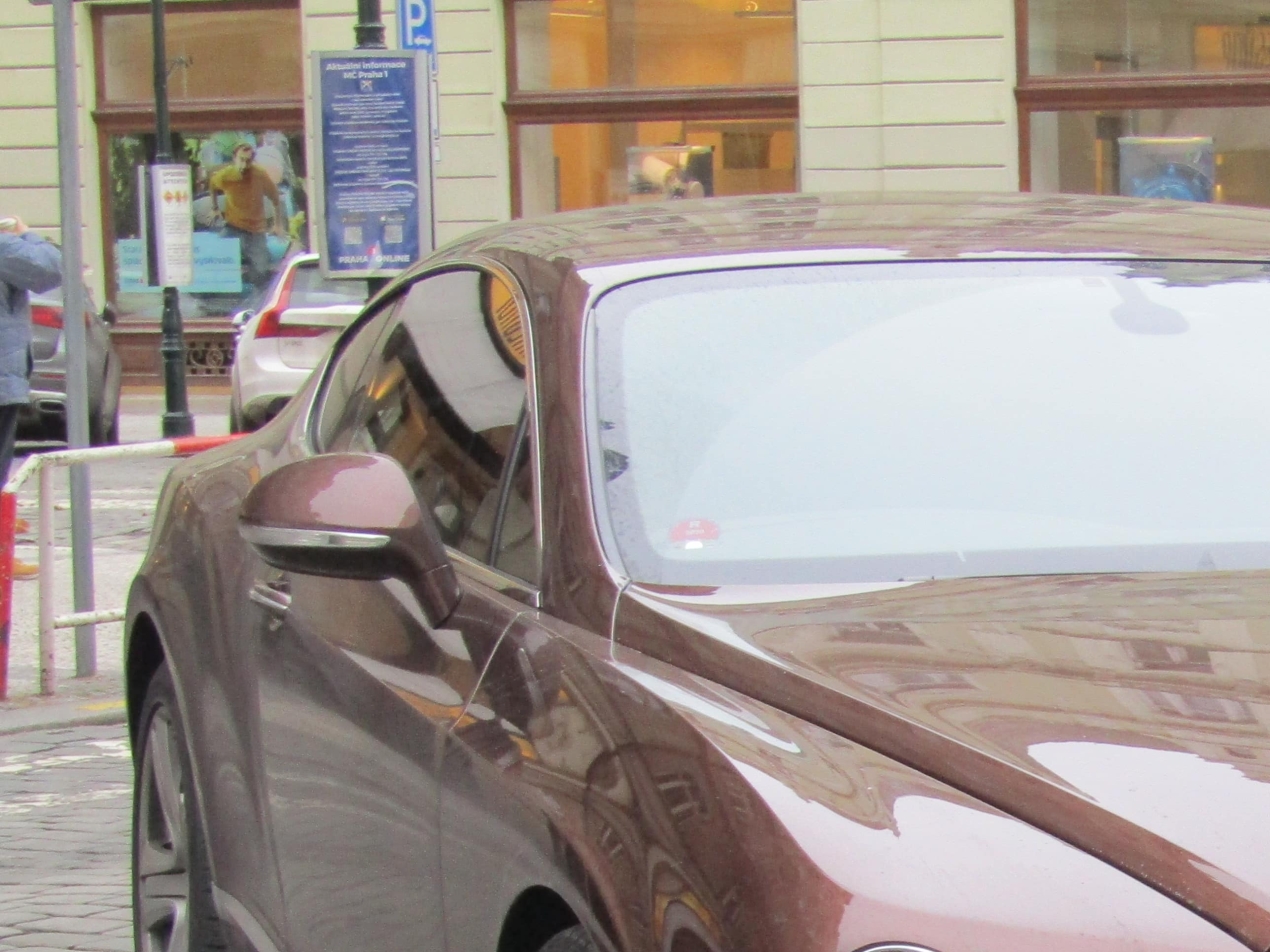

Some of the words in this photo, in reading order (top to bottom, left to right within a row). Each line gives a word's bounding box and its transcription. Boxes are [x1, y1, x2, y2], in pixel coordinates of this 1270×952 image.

[406, 0, 427, 46] P
[339, 255, 368, 264] PRAHA
[375, 254, 410, 263] ONLINE
